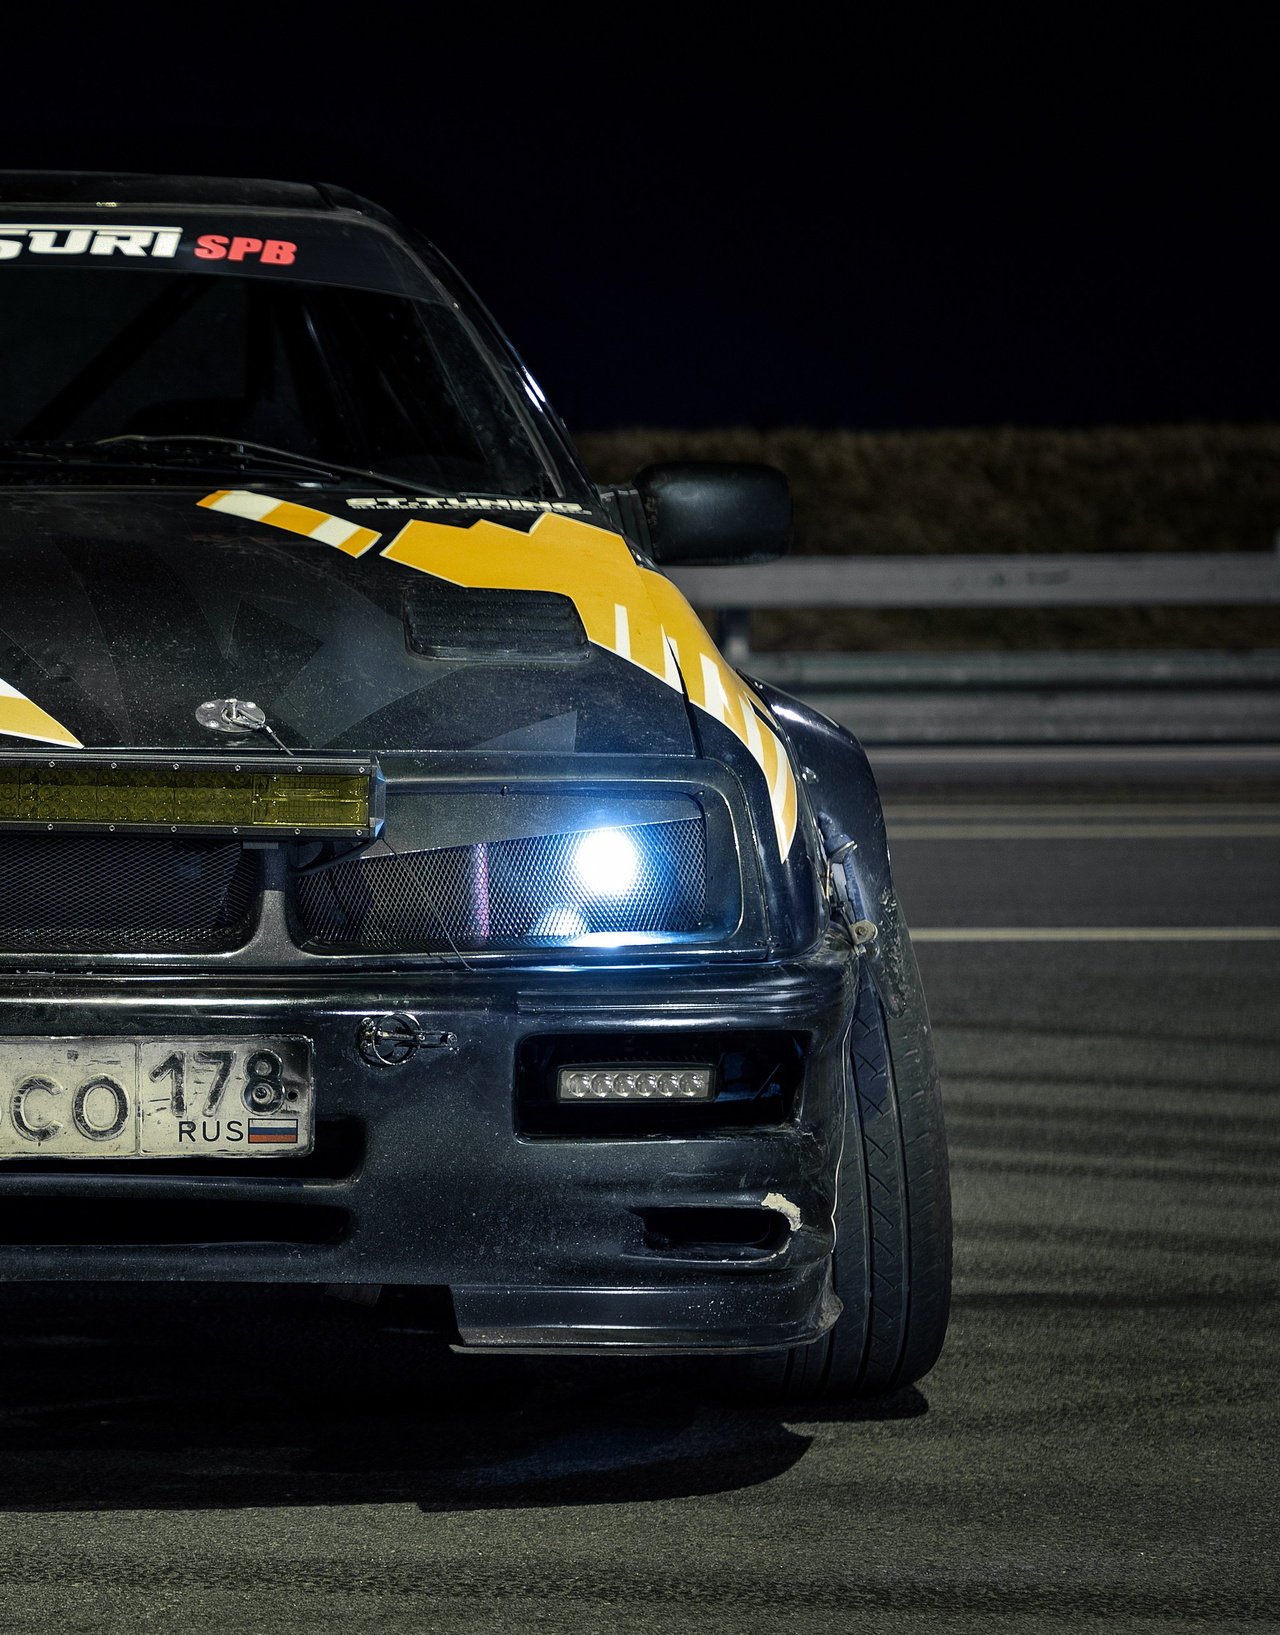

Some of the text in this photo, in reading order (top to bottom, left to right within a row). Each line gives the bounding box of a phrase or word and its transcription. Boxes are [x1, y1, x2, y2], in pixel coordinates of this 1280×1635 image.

[195, 234, 298, 266] SPB
[148, 1049, 285, 1117] 178
[178, 1121, 245, 1143] RUS
